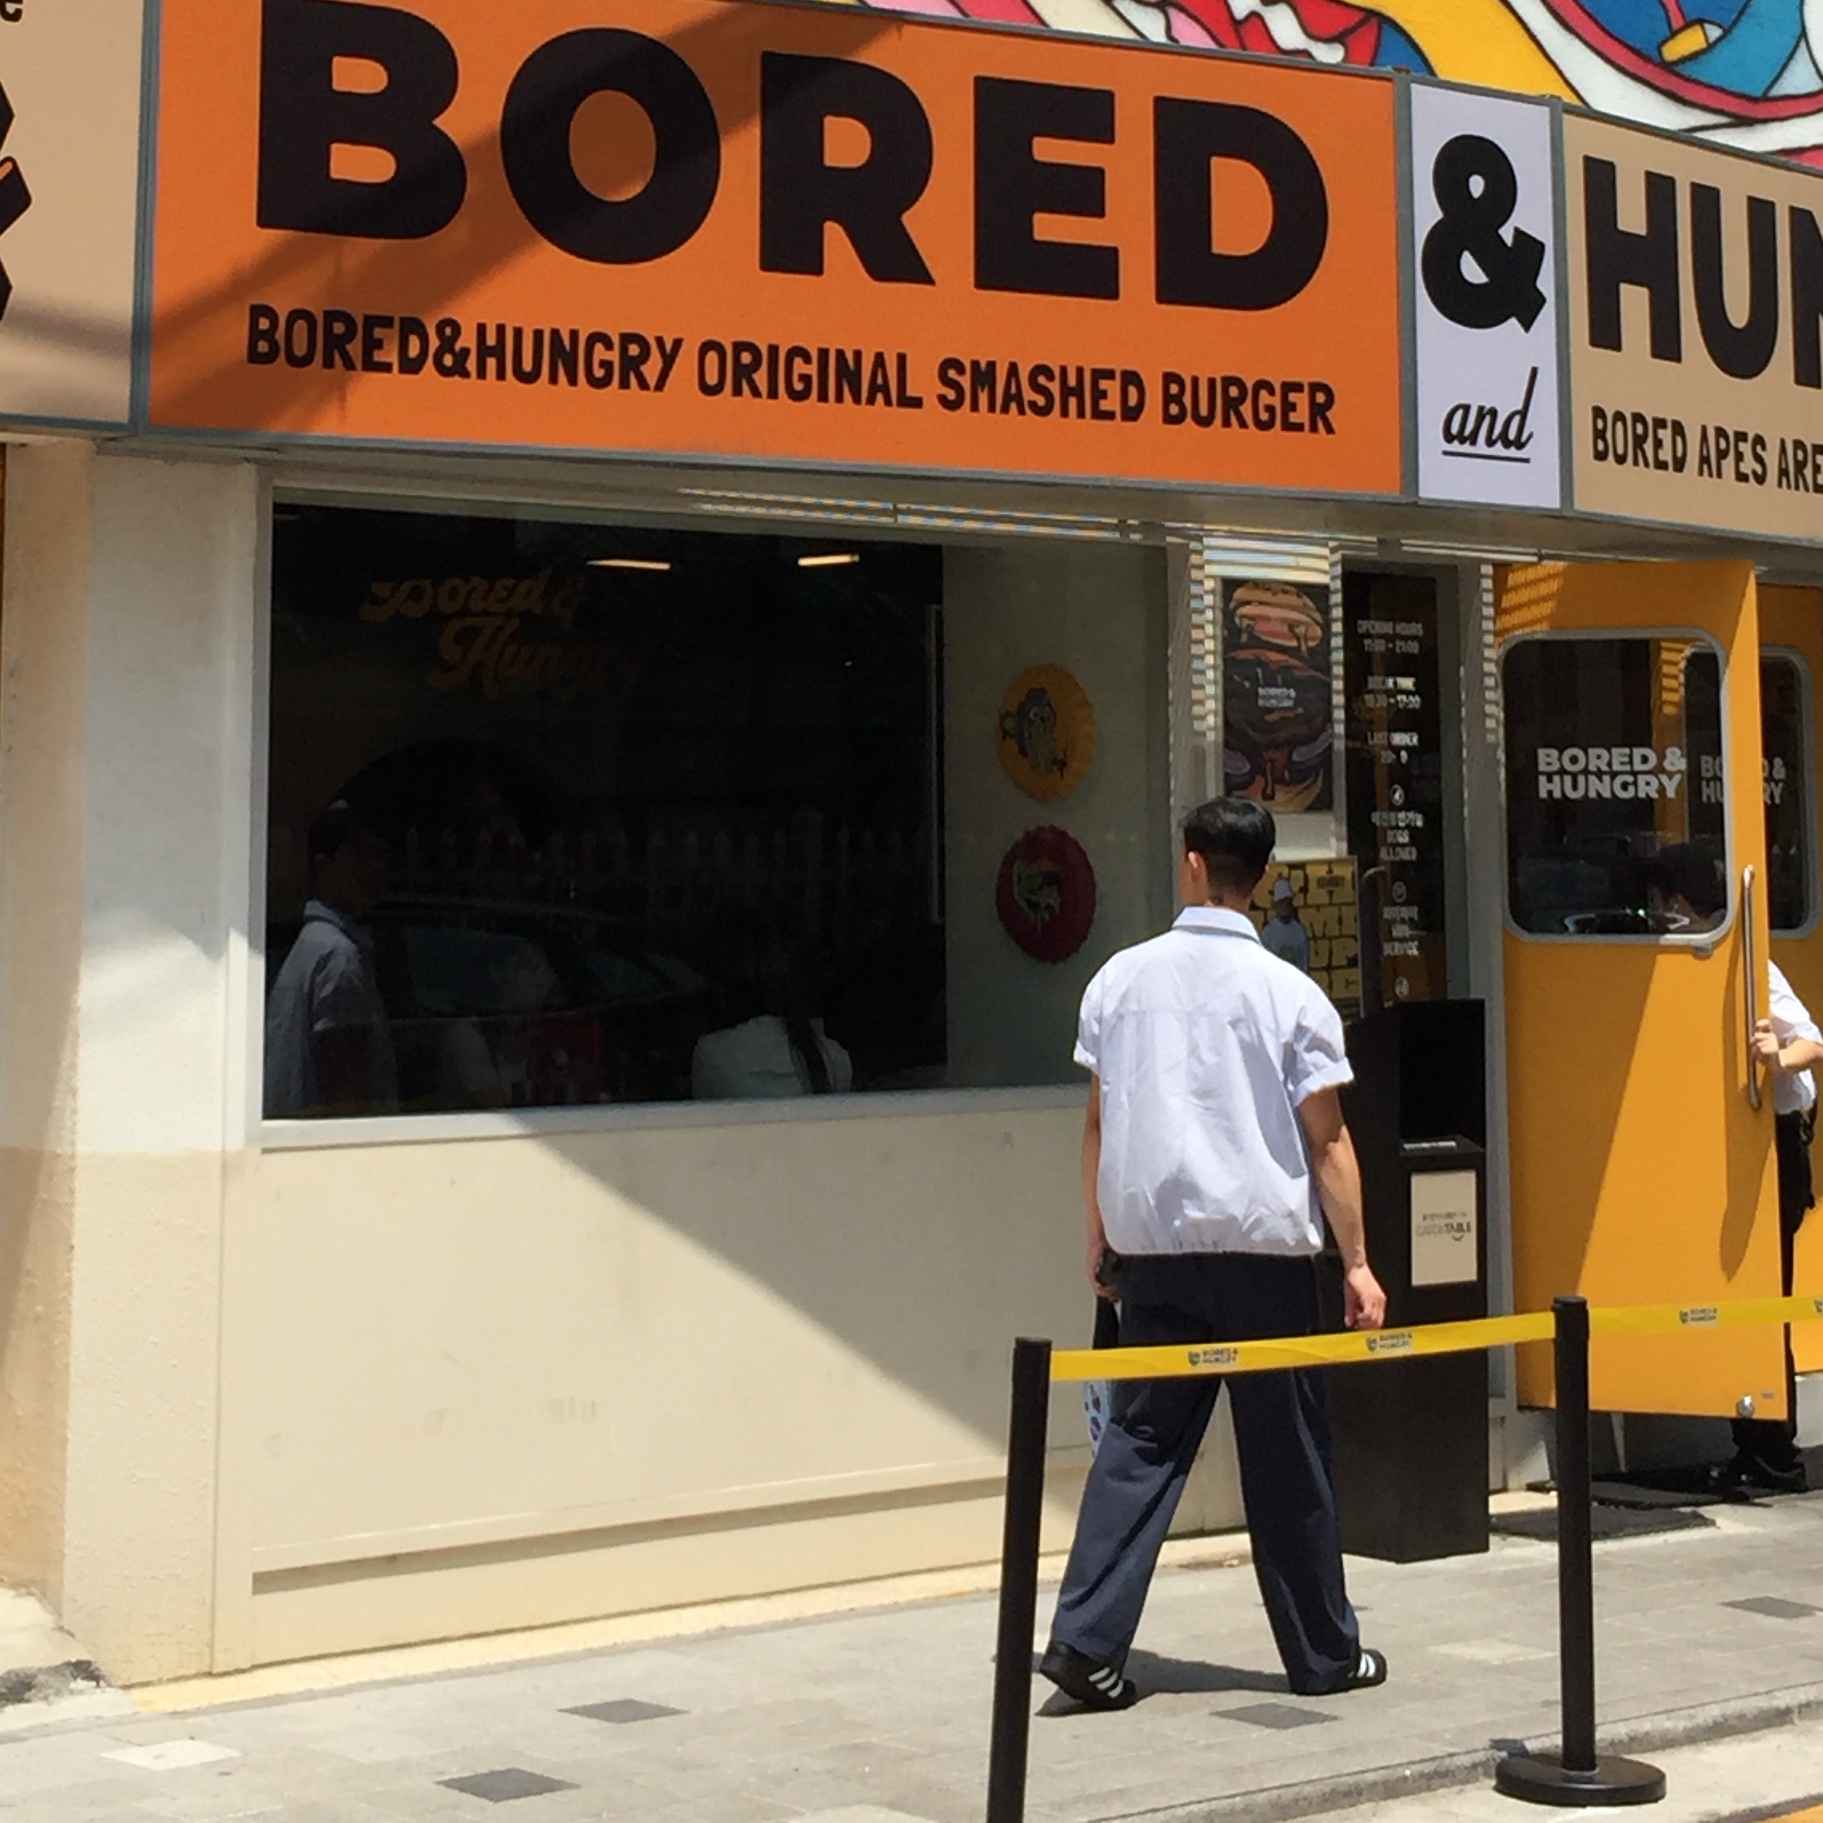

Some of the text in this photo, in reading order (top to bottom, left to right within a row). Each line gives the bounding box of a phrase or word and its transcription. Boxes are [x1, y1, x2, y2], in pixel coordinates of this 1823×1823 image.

[257, 0, 1328, 312] BORED
[1421, 133, 1547, 334] &
[247, 303, 1335, 434] BORED&HUNGRY ORIGINAL SMASHED BURGER
[1442, 366, 1537, 452] and
[1592, 405, 1688, 473] BORED
[1698, 424, 1768, 486] APES
[1537, 746, 1688, 772] BORED &
[1538, 774, 1682, 799] HUNGRY
